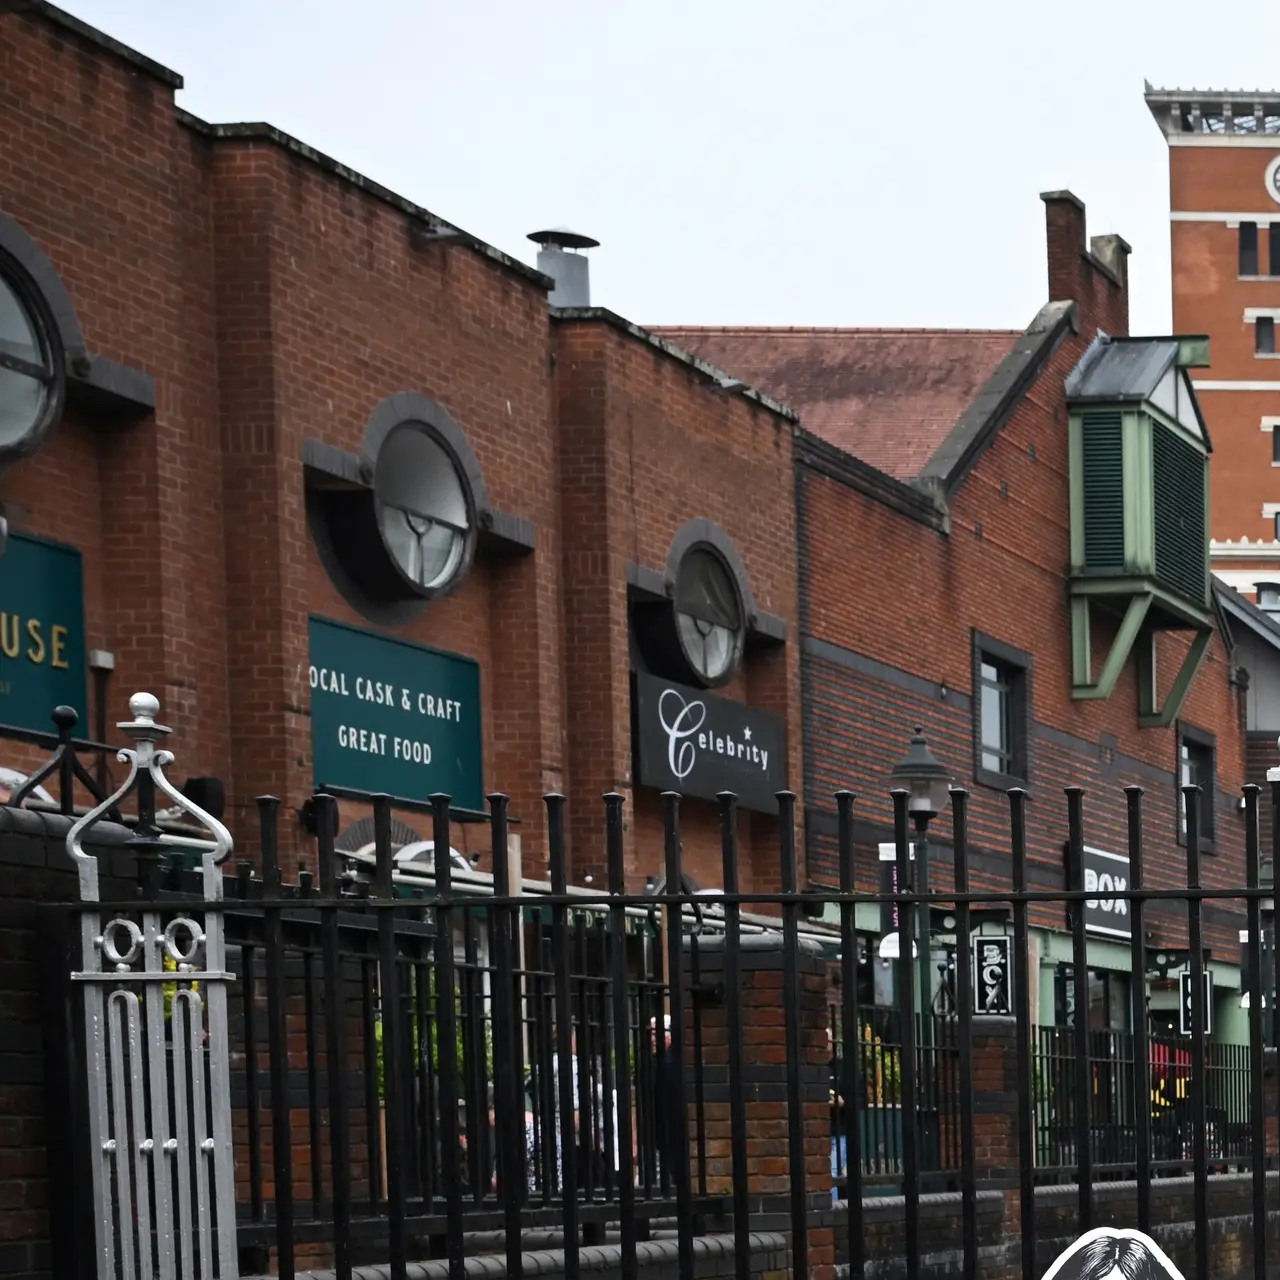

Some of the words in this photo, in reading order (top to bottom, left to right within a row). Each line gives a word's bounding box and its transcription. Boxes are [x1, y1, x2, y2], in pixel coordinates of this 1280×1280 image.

[356, 677, 394, 706] CASK
[401, 689, 412, 710] &
[418, 693, 461, 722] CRAFT
[338, 725, 386, 755] GREAT
[394, 734, 431, 764] FOOD
[658, 688, 768, 778] Celebrity
[1084, 868, 1127, 915] BOX
